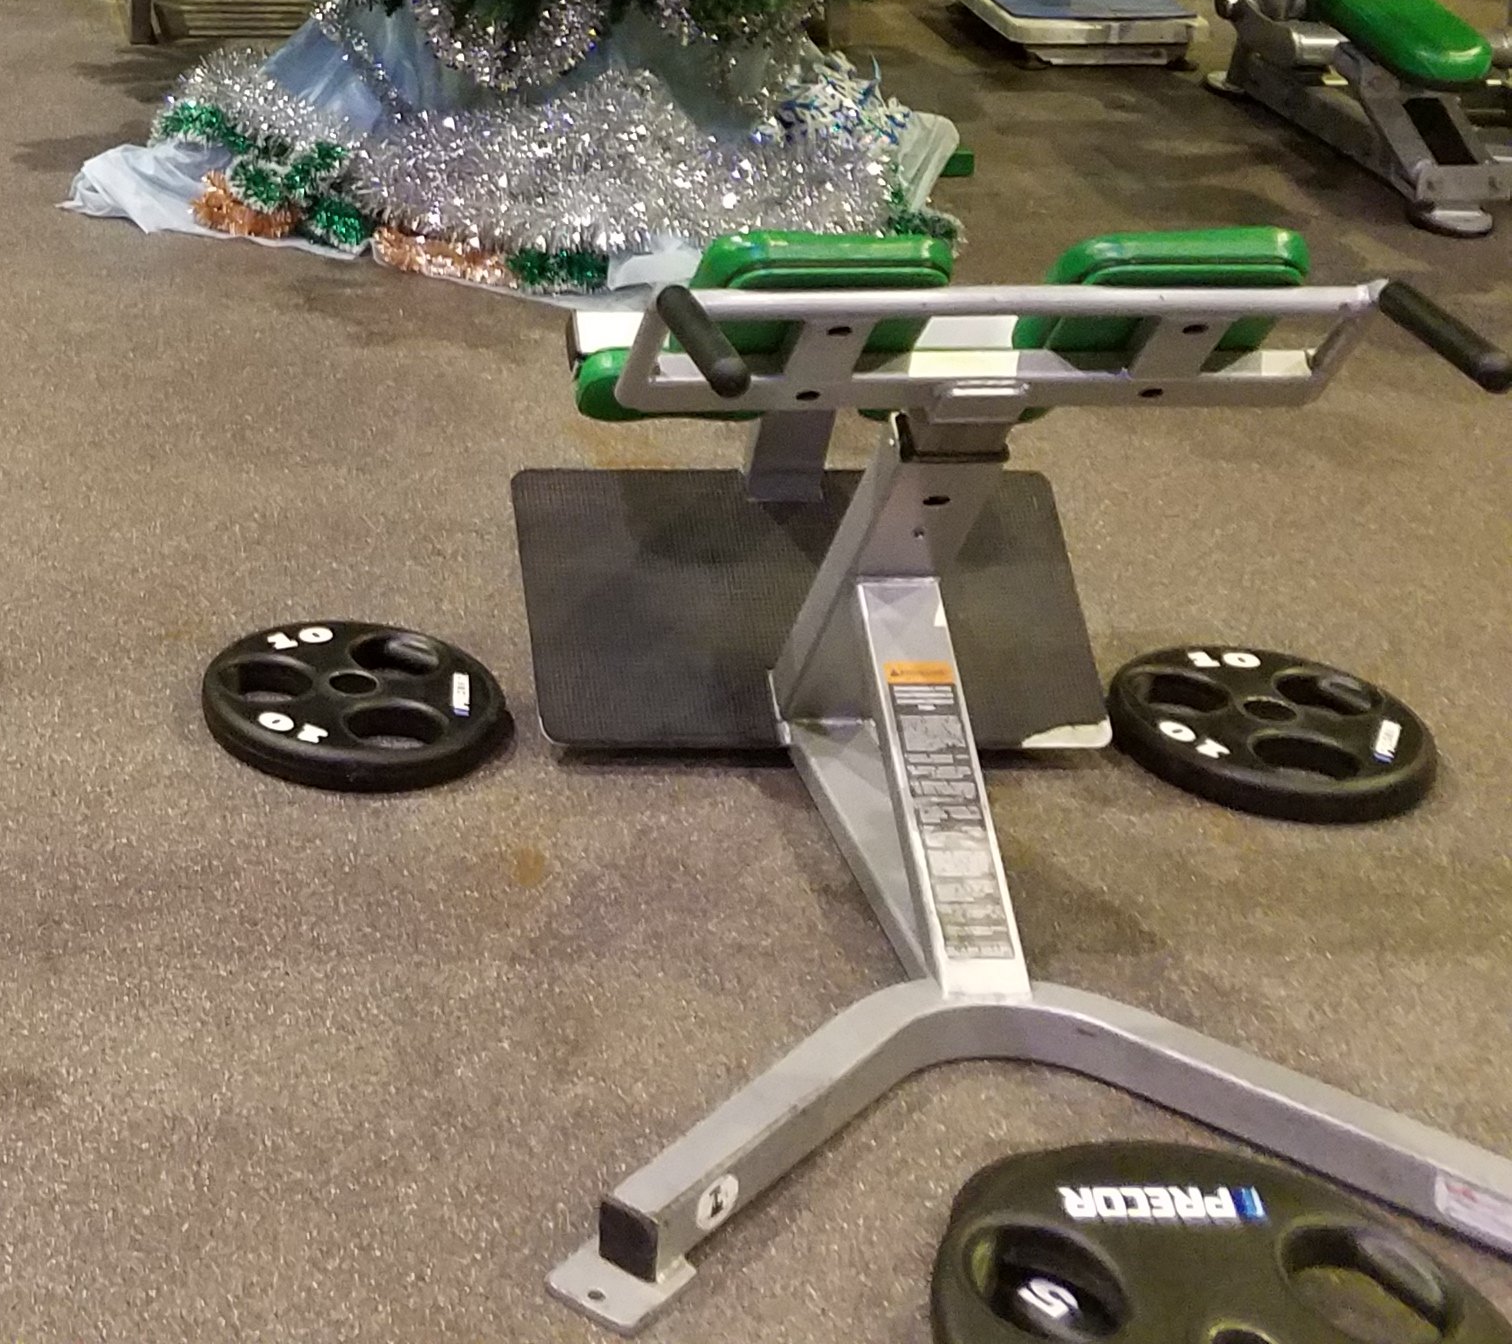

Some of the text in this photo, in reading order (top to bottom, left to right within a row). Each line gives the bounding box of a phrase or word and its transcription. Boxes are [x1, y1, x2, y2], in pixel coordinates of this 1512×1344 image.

[266, 626, 334, 650] 10
[1186, 650, 1262, 668] 10
[257, 711, 329, 744] 10
[1158, 720, 1231, 759] 10
[1057, 1185, 1240, 1222] PRECOR
